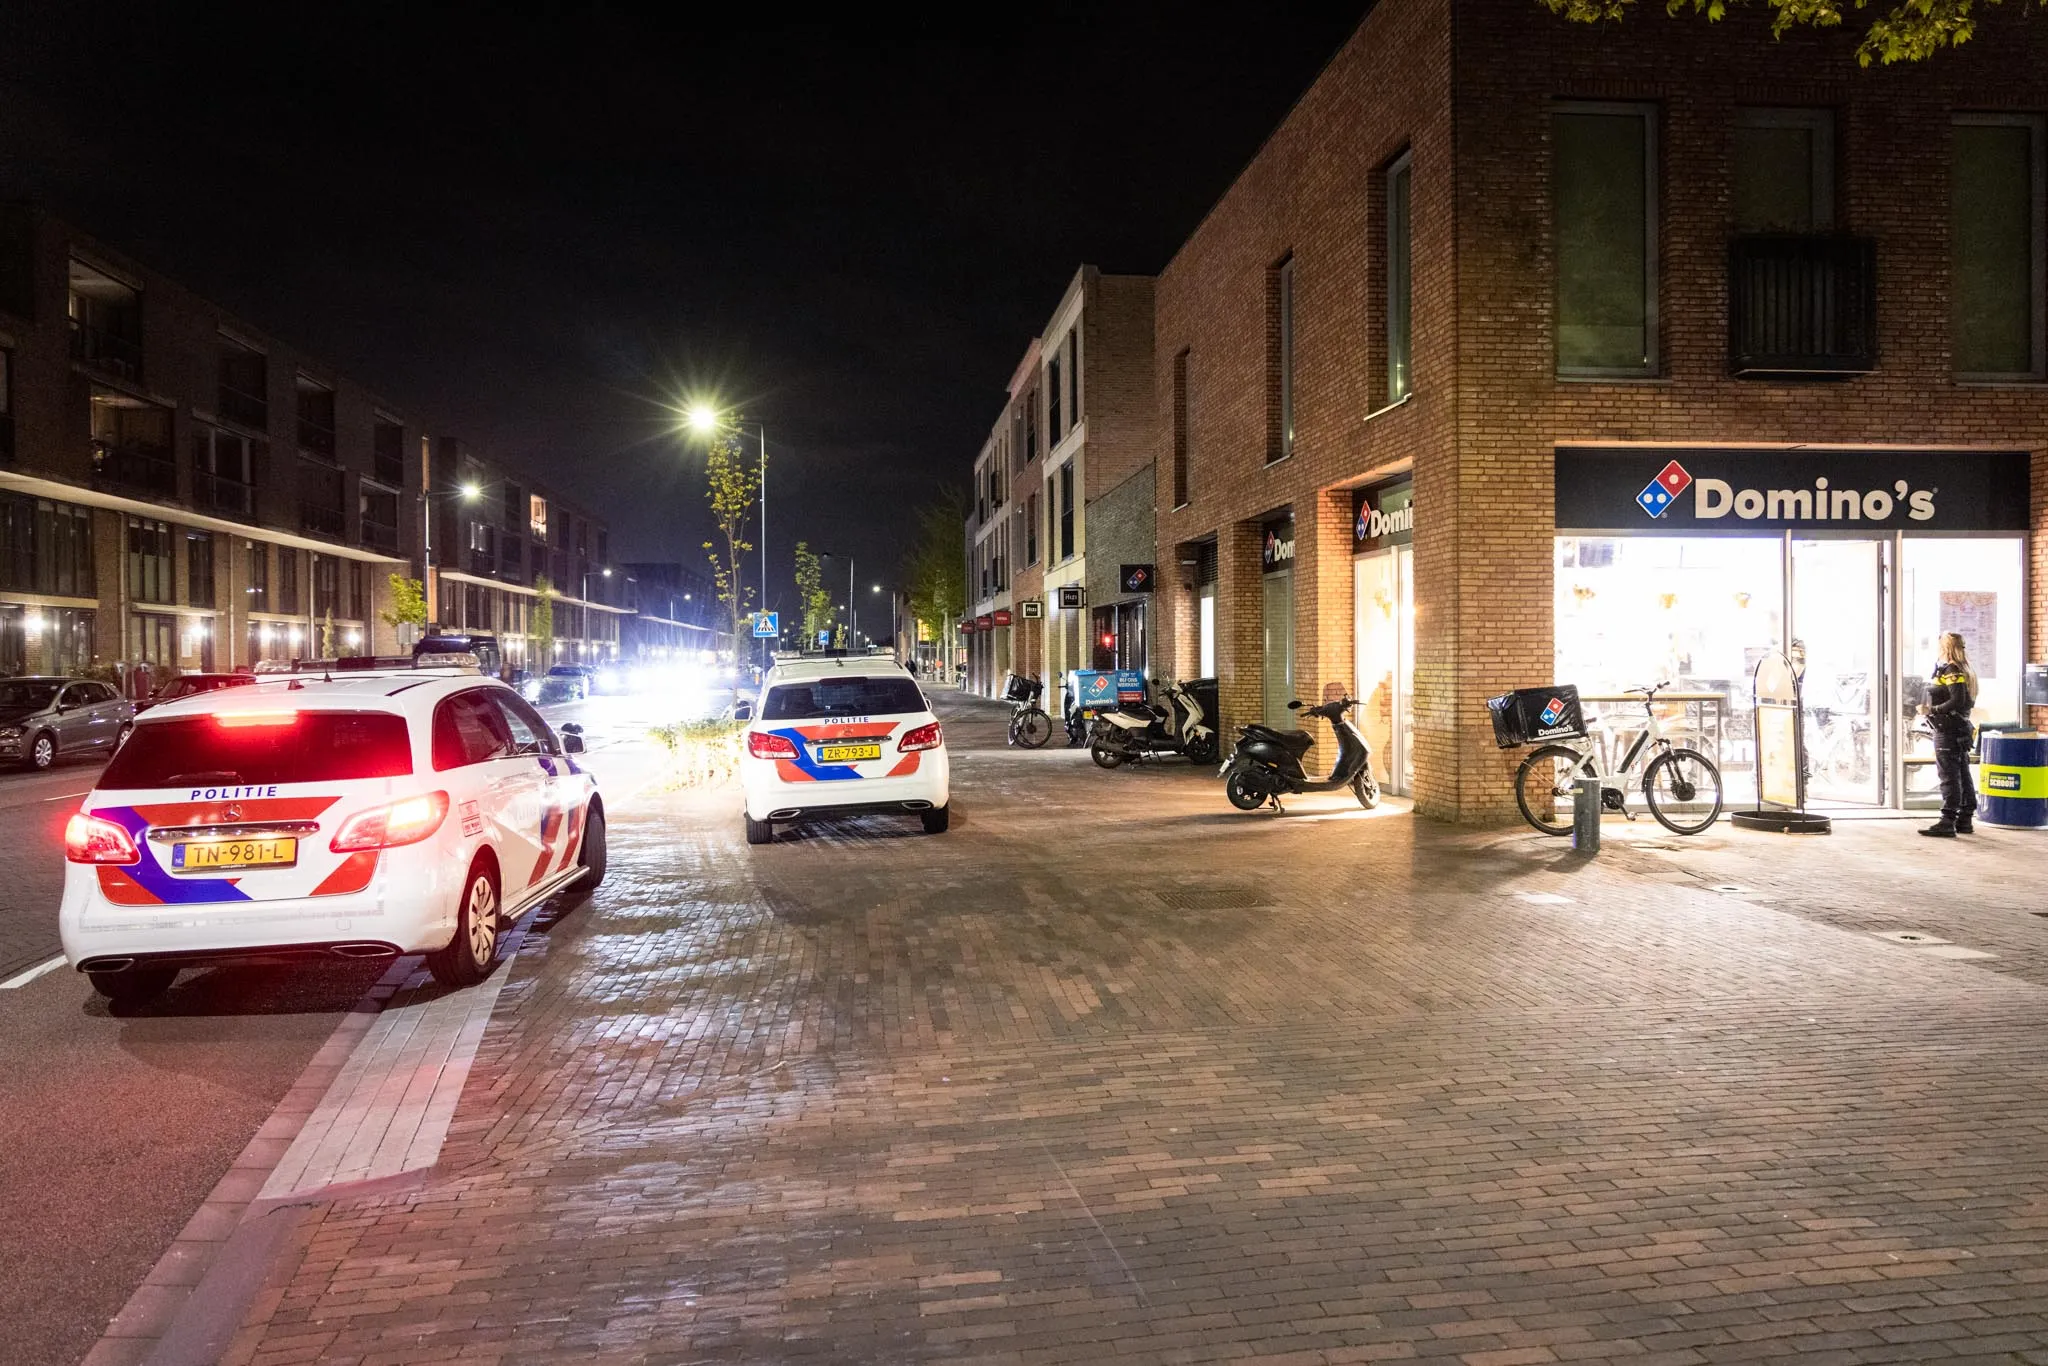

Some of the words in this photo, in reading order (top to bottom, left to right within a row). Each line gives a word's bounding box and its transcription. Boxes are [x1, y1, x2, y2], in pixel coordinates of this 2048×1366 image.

[1695, 476, 1936, 520] Domino's
[824, 717, 869, 725] POLITIE
[1537, 725, 1574, 737] Domino's
[827, 747, 874, 759] ZR-793-J
[191, 786, 278, 801] POLITIE
[194, 843, 284, 864] TN-981-L
